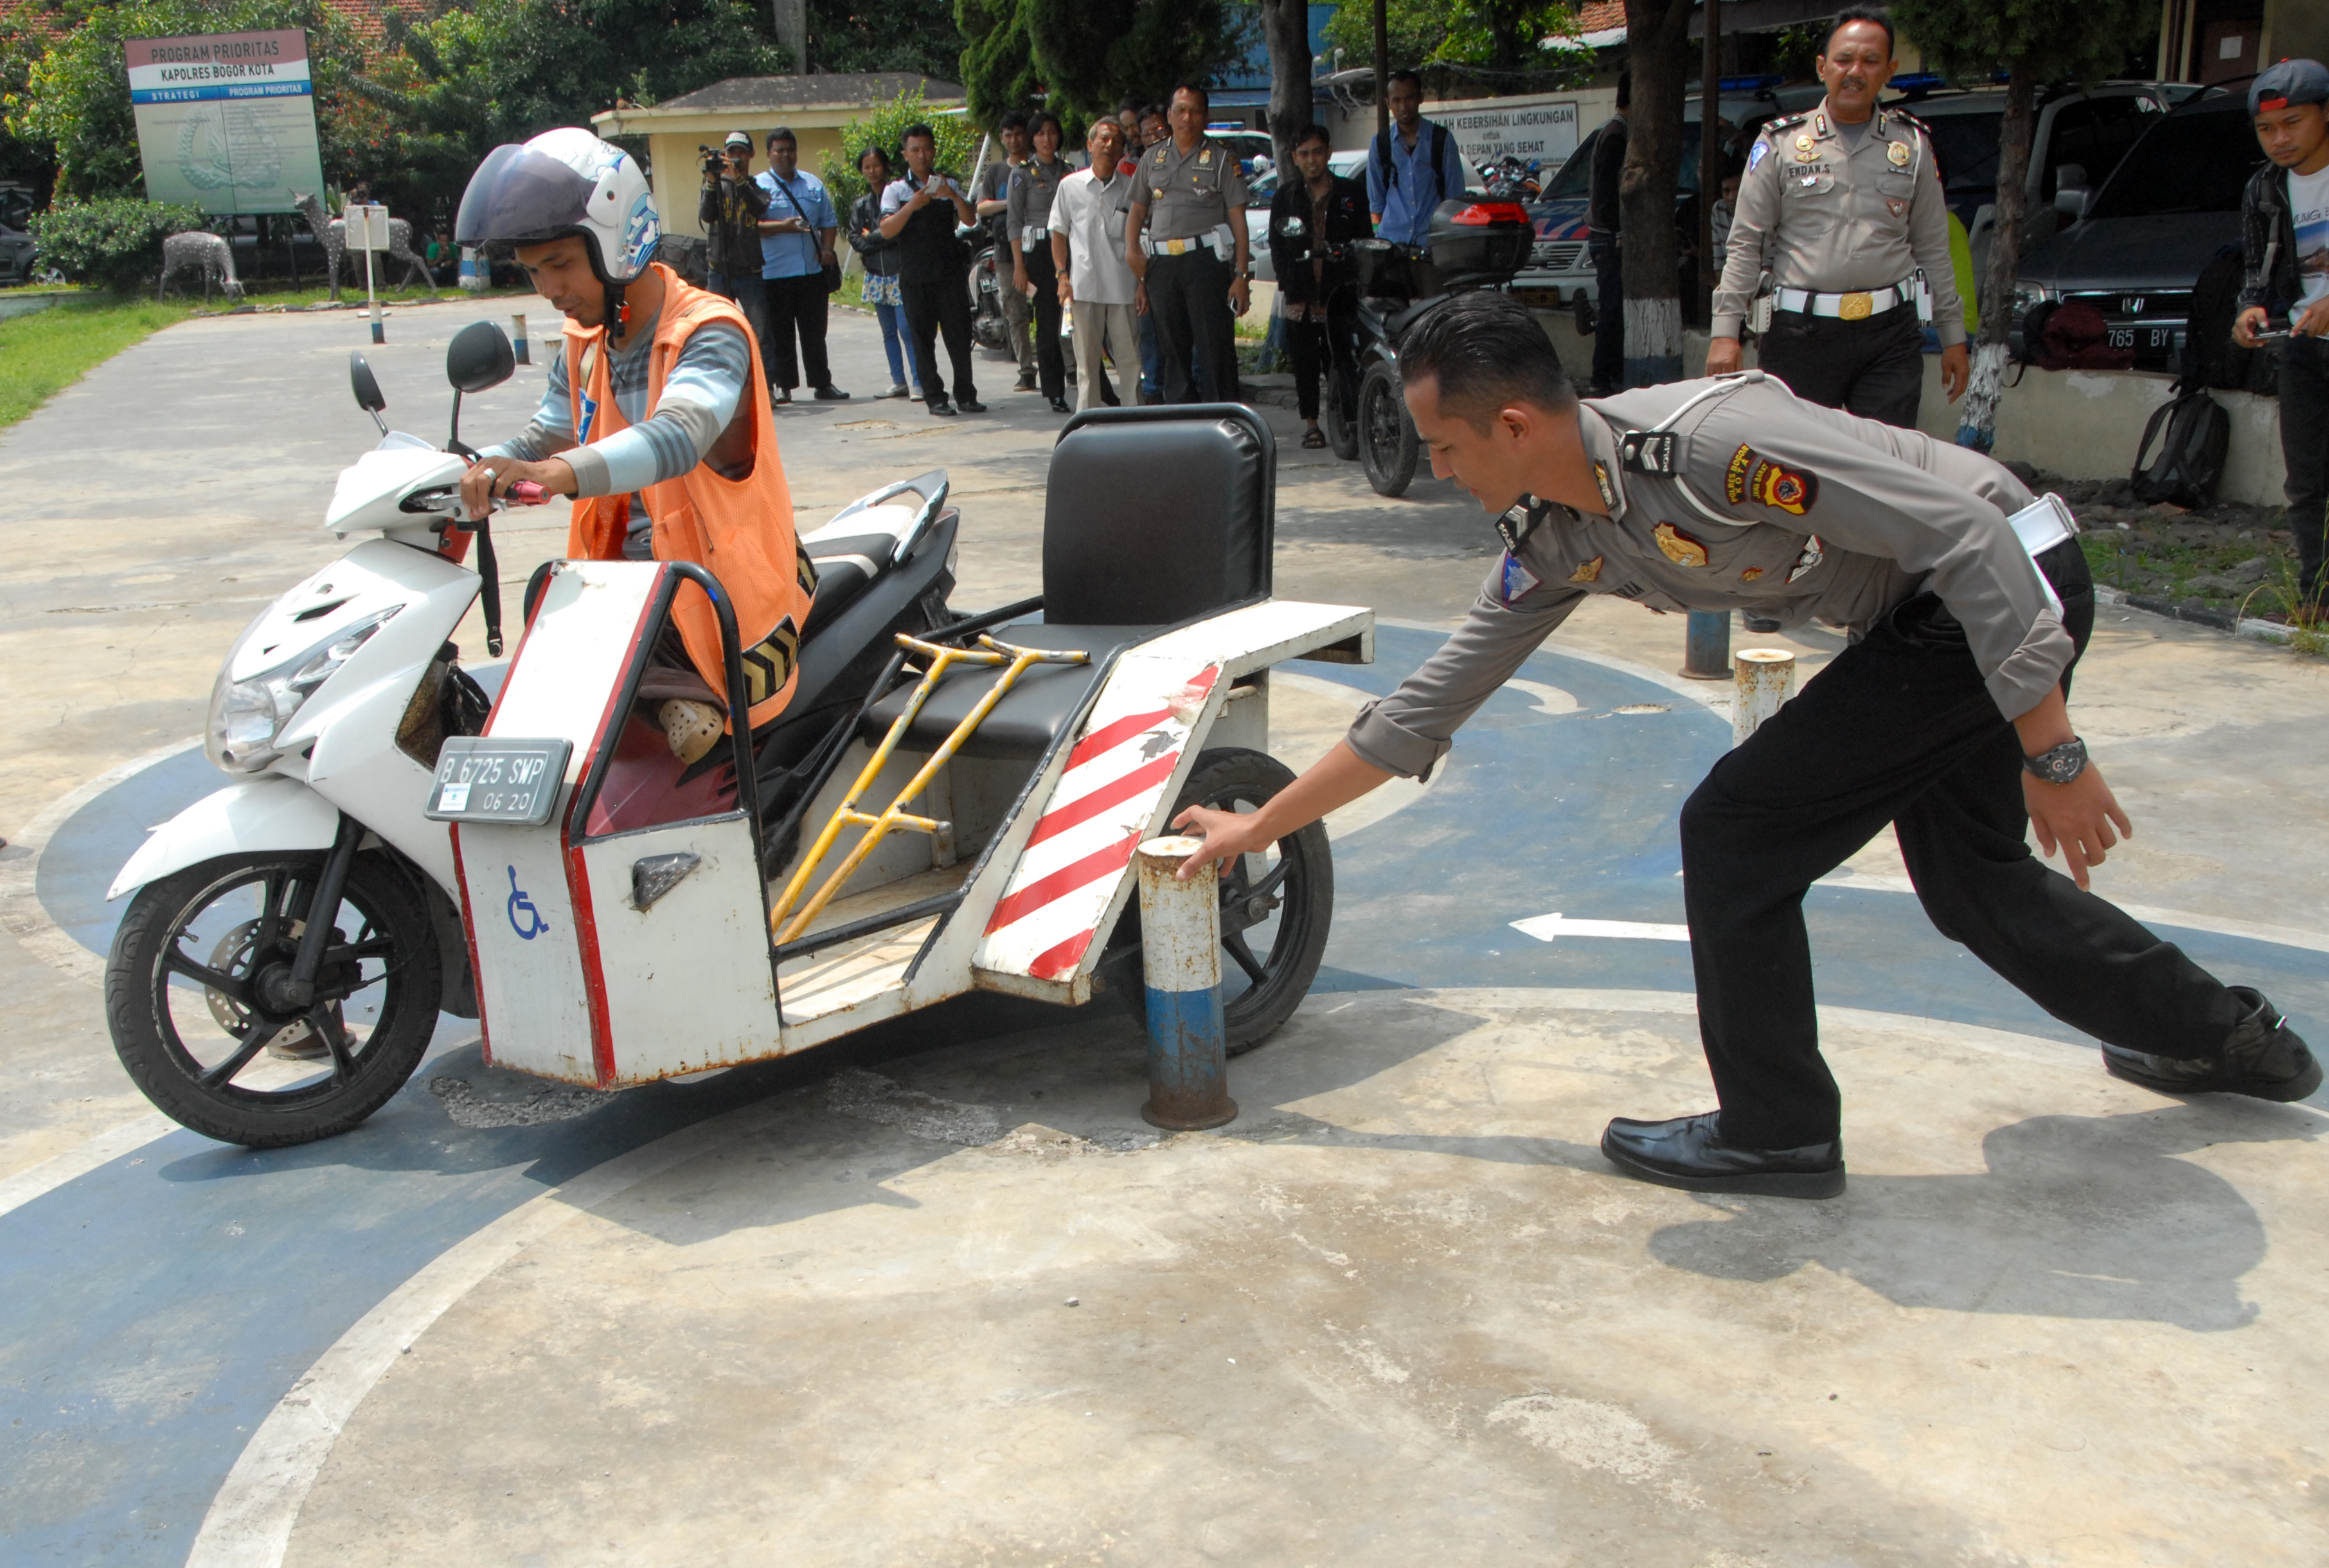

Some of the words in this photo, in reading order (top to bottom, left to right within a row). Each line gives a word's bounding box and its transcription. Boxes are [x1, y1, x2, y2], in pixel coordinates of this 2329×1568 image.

[151, 44, 210, 63] PROGRAM
[213, 40, 280, 59] PRIORITAS
[161, 66, 210, 82] KAPOLRES
[213, 64, 245, 78] BOGOR
[249, 63, 274, 76] KOTA
[152, 91, 200, 101] STRATEGI
[229, 86, 264, 96] PROGRAM
[265, 84, 302, 94] PRIORITAS
[1456, 114, 1510, 129] KEBERSIHAN
[1512, 109, 1573, 126] LINGKUNGAN
[1483, 130, 1501, 140] untuk
[1467, 143, 1492, 156] DEPAN
[1493, 141, 1515, 155] YANG
[1517, 141, 1544, 154] SEHAT
[2107, 330, 2134, 347] 765
[2150, 328, 2170, 347] BY
[1731, 445, 1750, 473] BOGOR
[1727, 473, 1738, 503] POLRES
[440, 758, 456, 783] B
[459, 758, 504, 785] 6725
[508, 758, 544, 785] SWP
[483, 792, 503, 810] 06
[508, 792, 530, 810] 20
